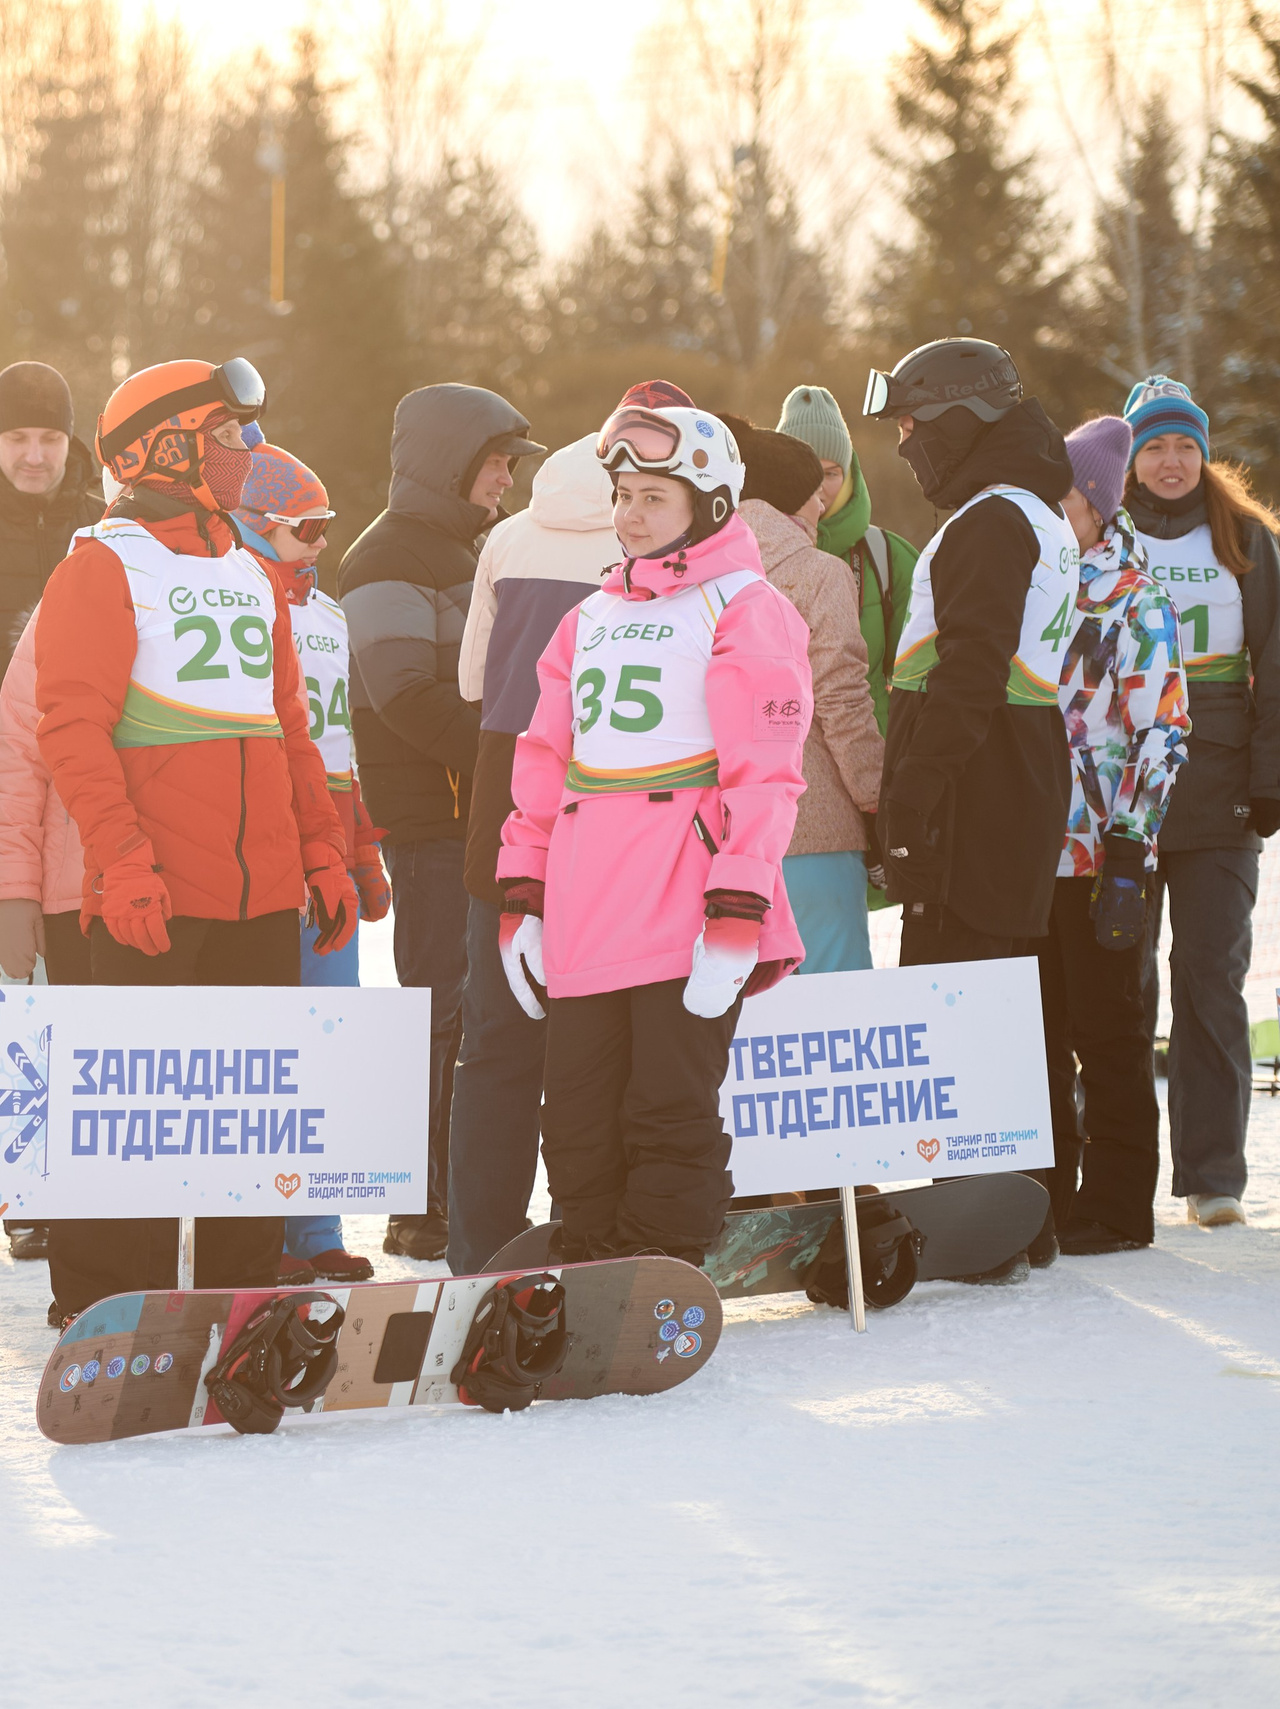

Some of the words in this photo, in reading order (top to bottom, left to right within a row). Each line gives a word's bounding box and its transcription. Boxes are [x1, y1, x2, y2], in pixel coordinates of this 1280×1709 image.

[1151, 566, 1220, 583] СБЕР
[173, 614, 273, 683] 29
[306, 633, 340, 654] СБЕР
[611, 623, 674, 641] СБЕР
[305, 676, 352, 741] 64
[576, 665, 664, 735] 35
[729, 1023, 930, 1081] ТВЕРСКОЕ
[72, 1049, 299, 1101] ЗАПАДНОЕ
[732, 1076, 958, 1139] ОТДЕЛЕНИЕ
[71, 1108, 325, 1161] ОТДЕЛЕНИЕ
[946, 1134, 982, 1148] ТУРНИР
[985, 1132, 997, 1145] ПО
[999, 1129, 1038, 1142] ЗИМНИМ
[947, 1147, 979, 1161] ВИДАМ
[981, 1144, 1017, 1158] СПОРТА
[308, 1172, 348, 1185] ТУРНИР
[351, 1172, 365, 1184] ПО
[367, 1171, 411, 1184] ЗИМНИМ
[308, 1186, 343, 1200] ВИДАМ
[346, 1186, 386, 1198] СПОРТА
